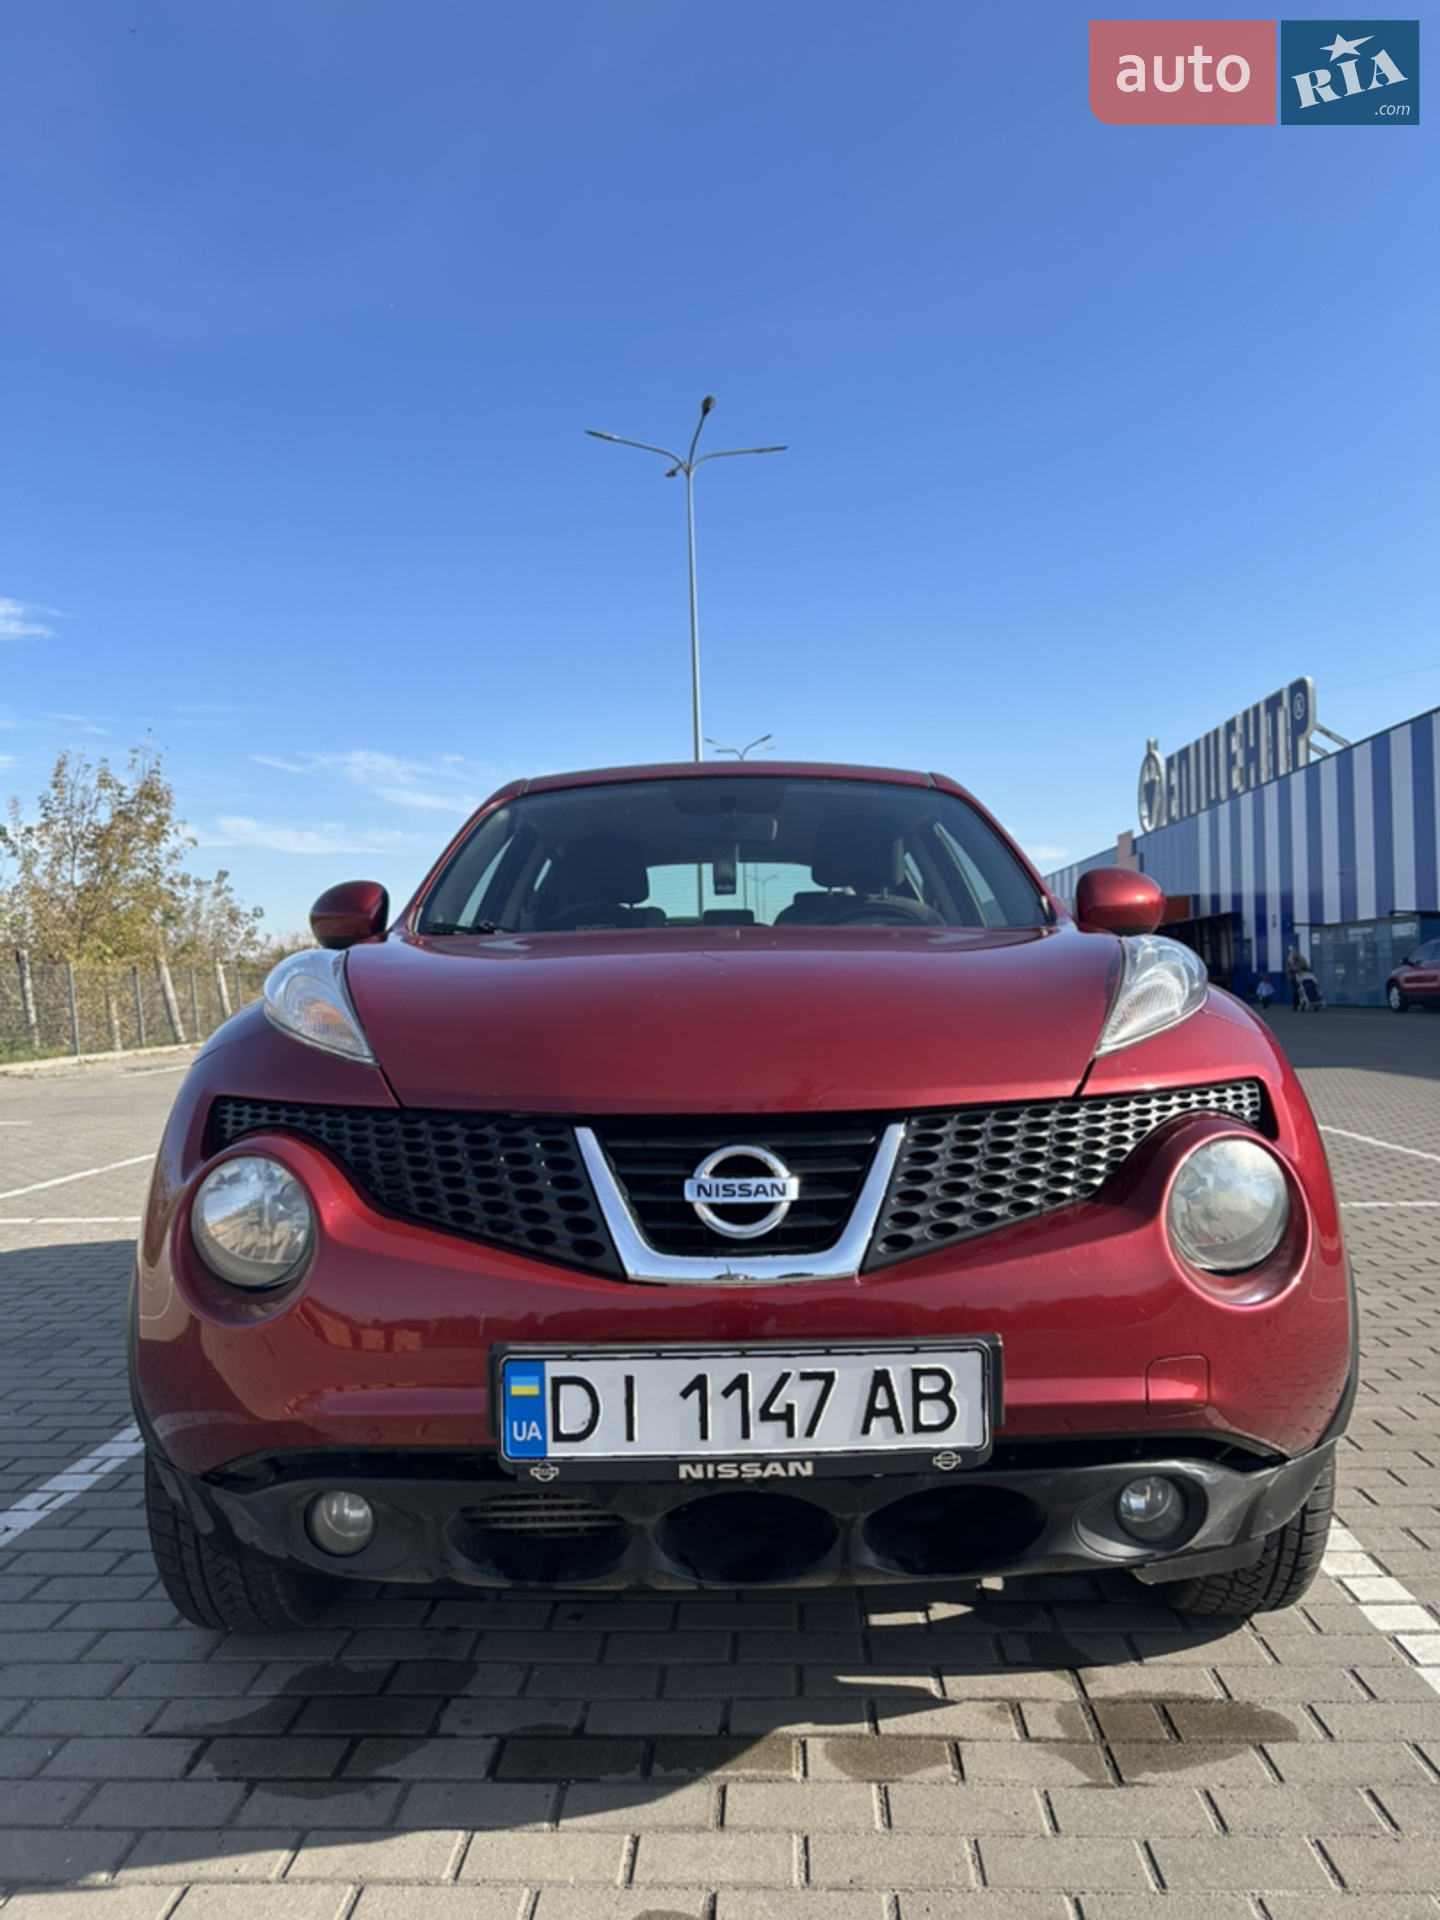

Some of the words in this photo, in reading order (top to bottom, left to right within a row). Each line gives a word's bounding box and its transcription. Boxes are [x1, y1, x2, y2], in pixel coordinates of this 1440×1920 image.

[696, 1183, 787, 1198] NISSAN
[551, 1375, 635, 1443] DI
[679, 1370, 836, 1441] 1147
[861, 1367, 958, 1435] AB
[512, 1421, 543, 1441] UA
[678, 1461, 814, 1479] NISSAN
